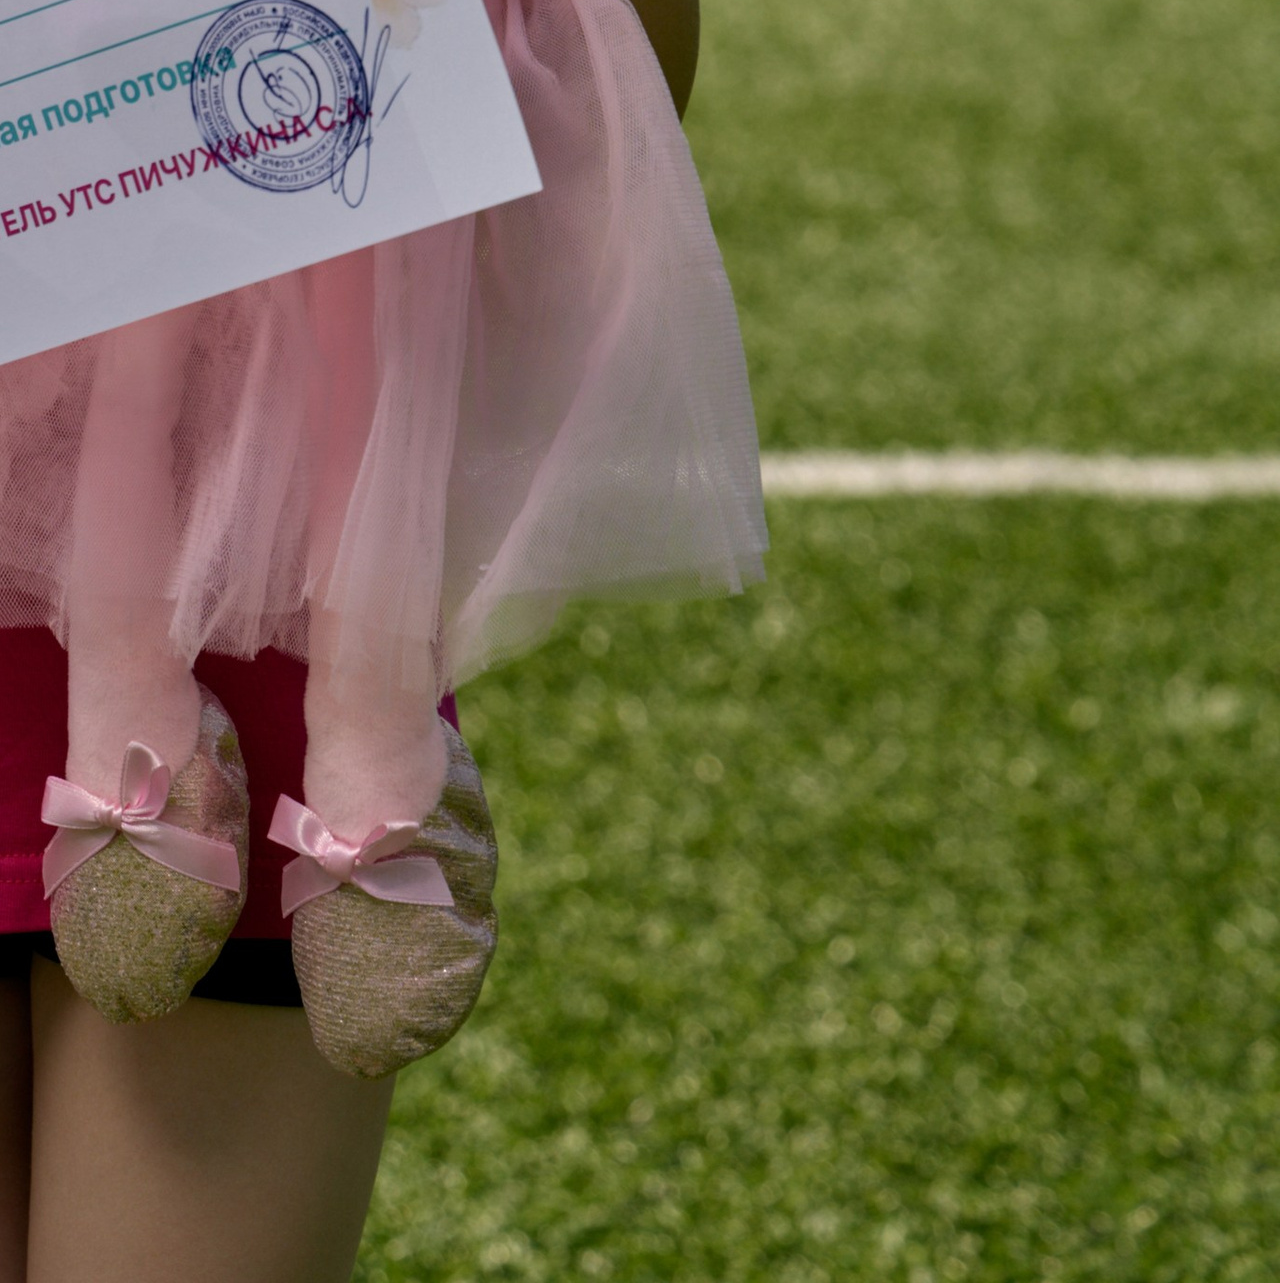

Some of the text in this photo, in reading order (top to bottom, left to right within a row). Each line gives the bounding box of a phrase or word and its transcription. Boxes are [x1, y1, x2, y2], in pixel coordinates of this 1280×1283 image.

[41, 45, 237, 130] подготовка
[58, 179, 116, 218] УТС
[118, 115, 312, 197] ПИЧУЖКИНА
[314, 96, 373, 134] С.А.
